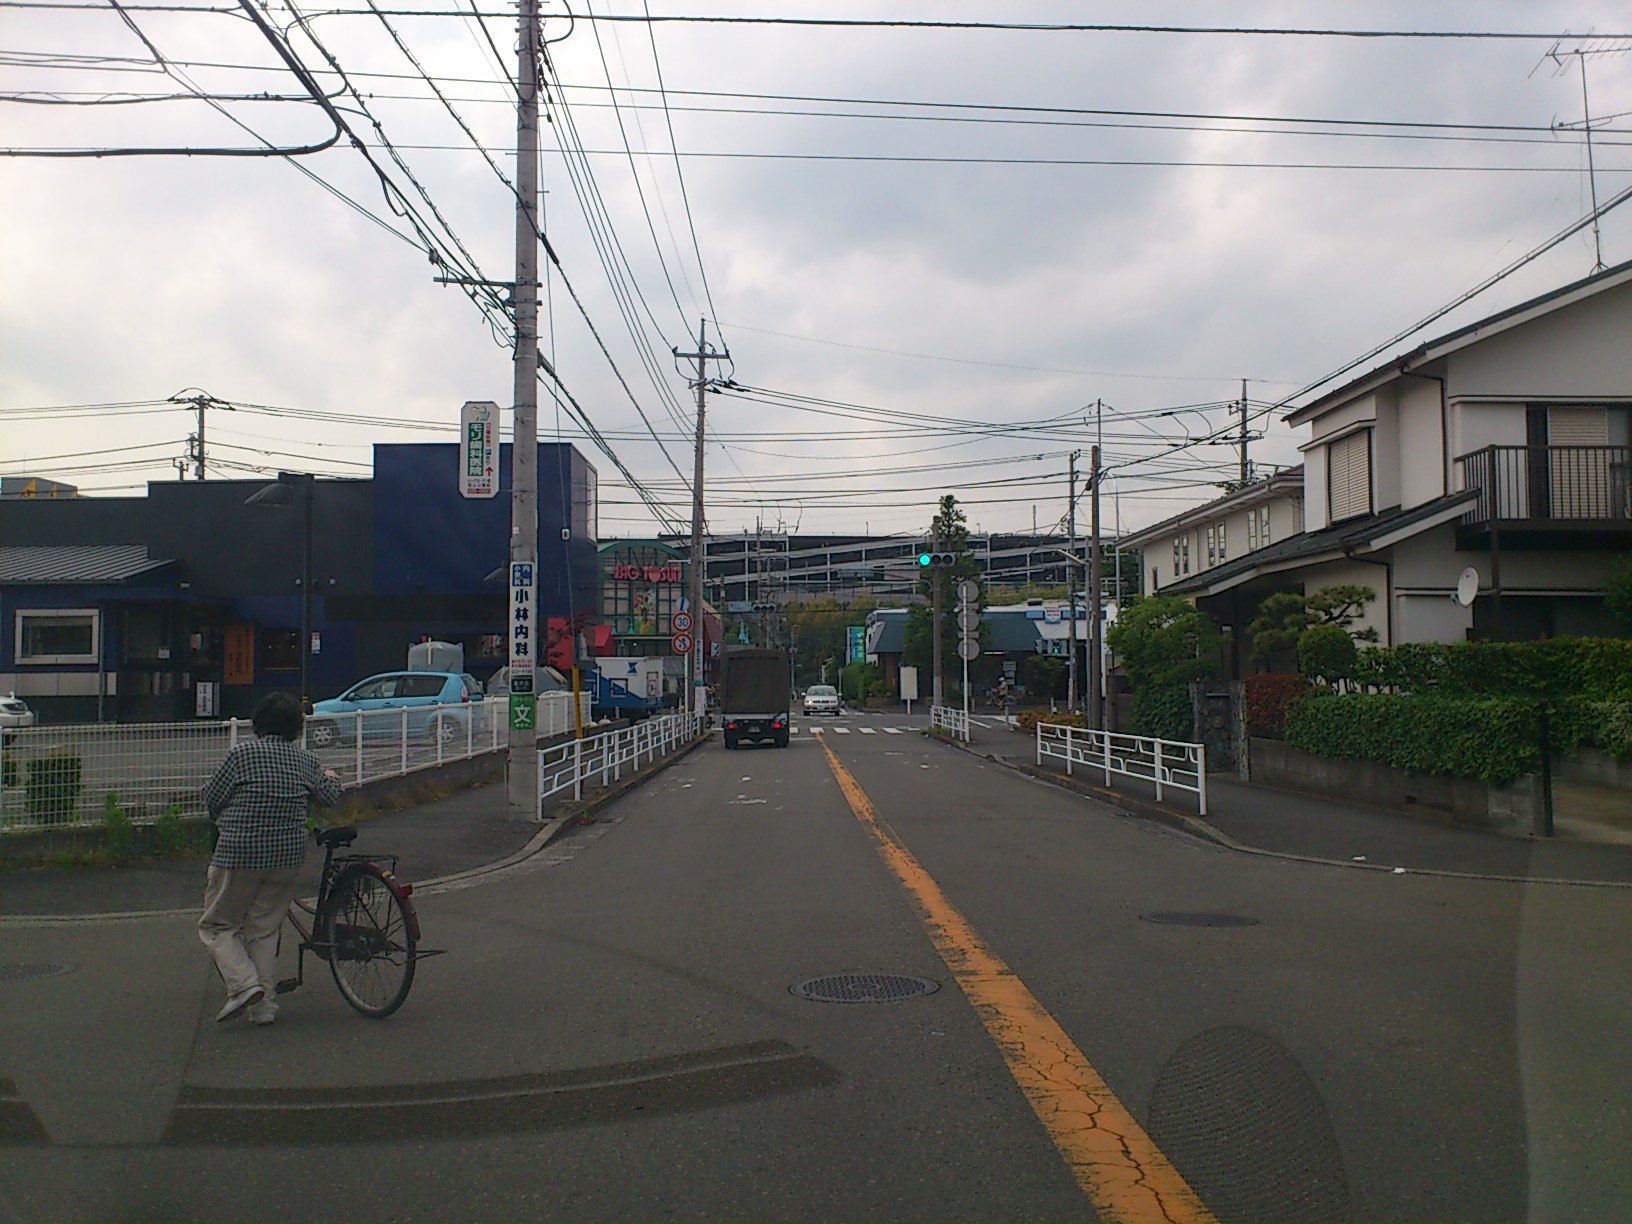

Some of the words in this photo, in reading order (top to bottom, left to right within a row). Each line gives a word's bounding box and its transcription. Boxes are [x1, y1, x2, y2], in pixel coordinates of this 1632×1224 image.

[613, 564, 640, 580] BIG
[515, 588, 529, 656] 小林内科
[677, 617, 689, 627] 30
[513, 704, 531, 723] 文
